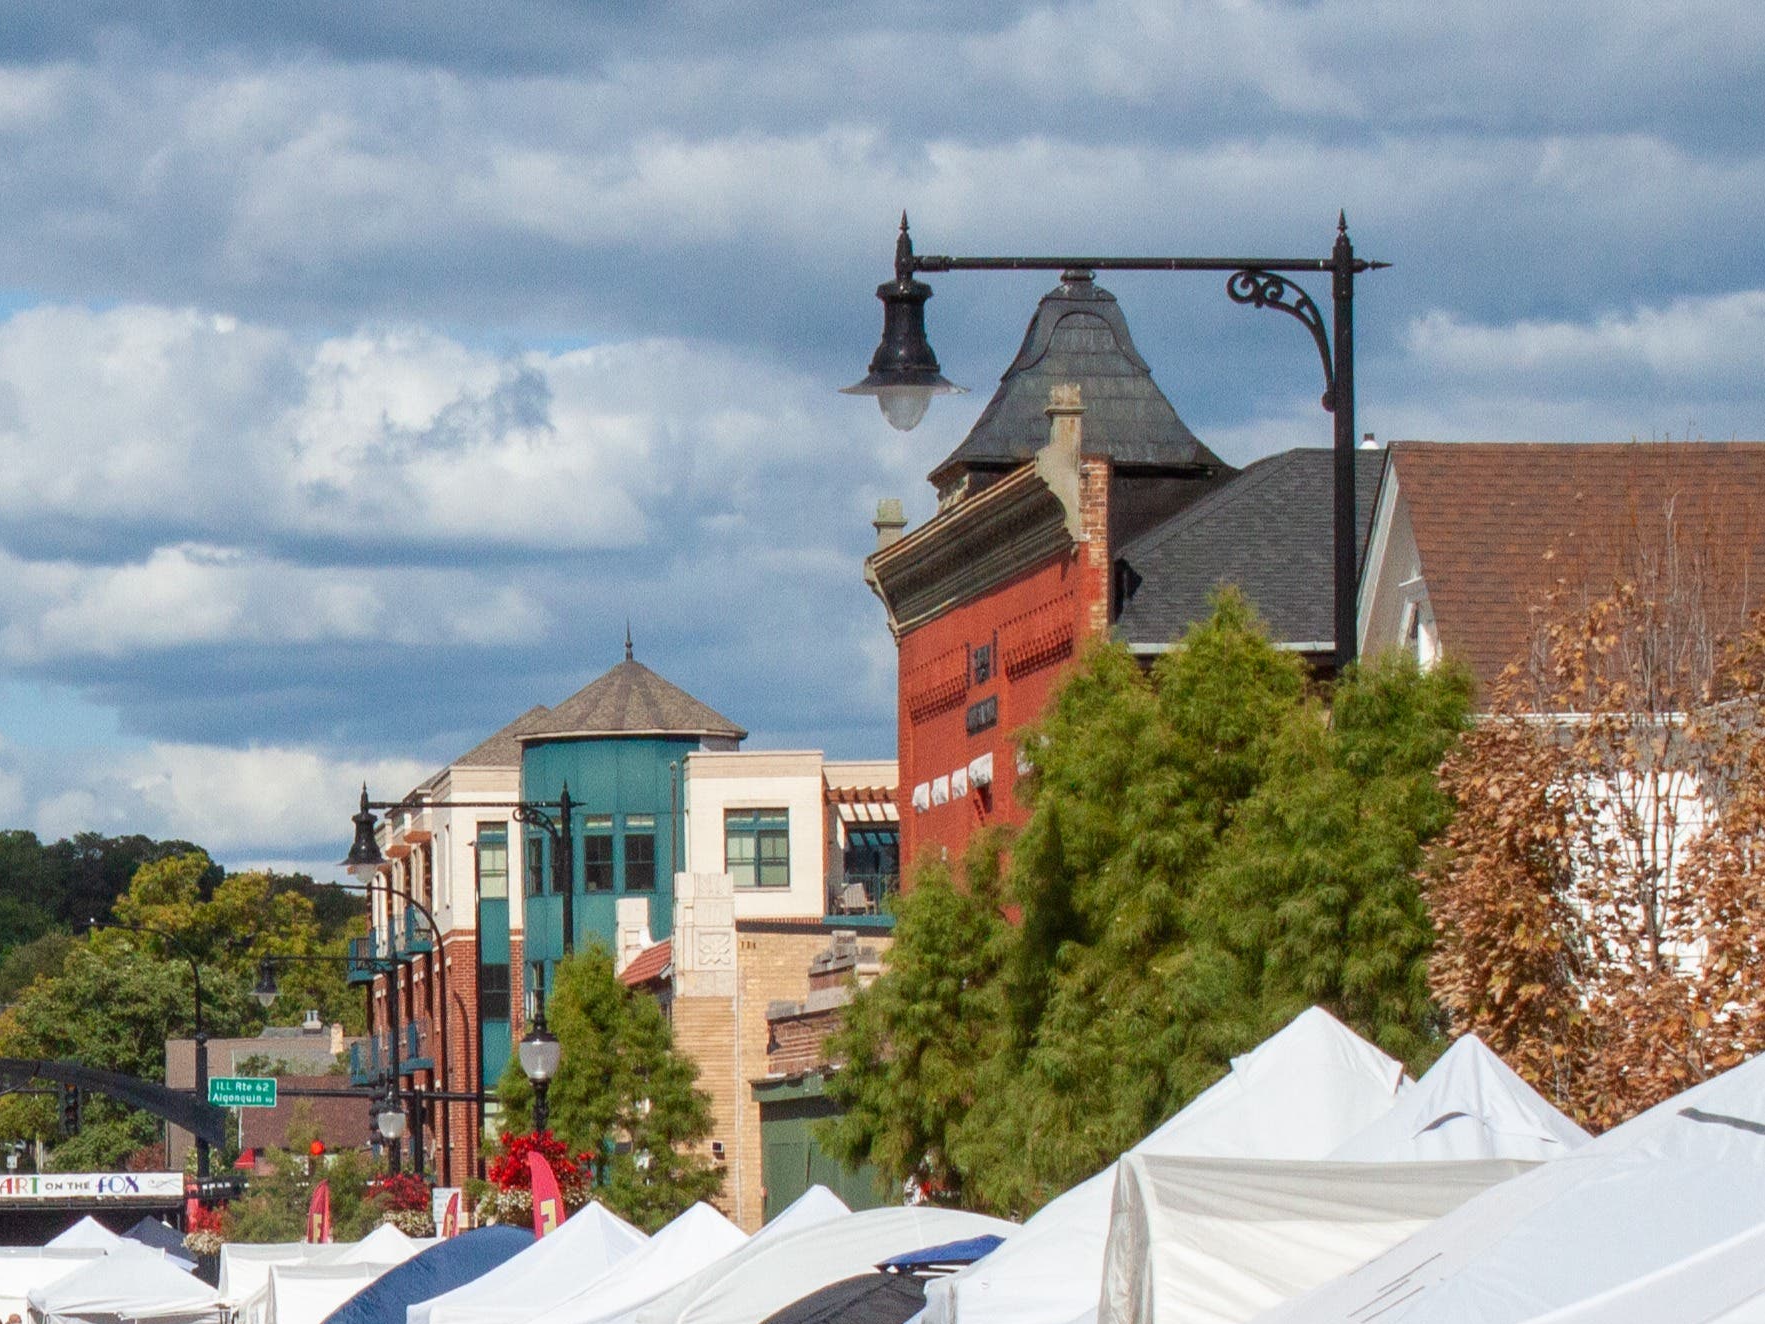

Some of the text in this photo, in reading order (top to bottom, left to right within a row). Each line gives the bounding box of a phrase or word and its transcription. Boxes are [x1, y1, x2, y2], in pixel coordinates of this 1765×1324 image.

[216, 1081, 270, 1092] ILL Rte 62
[212, 1092, 262, 1105] Algonquin
[45, 1181, 63, 1190] ON
[68, 1181, 90, 1190] THE
